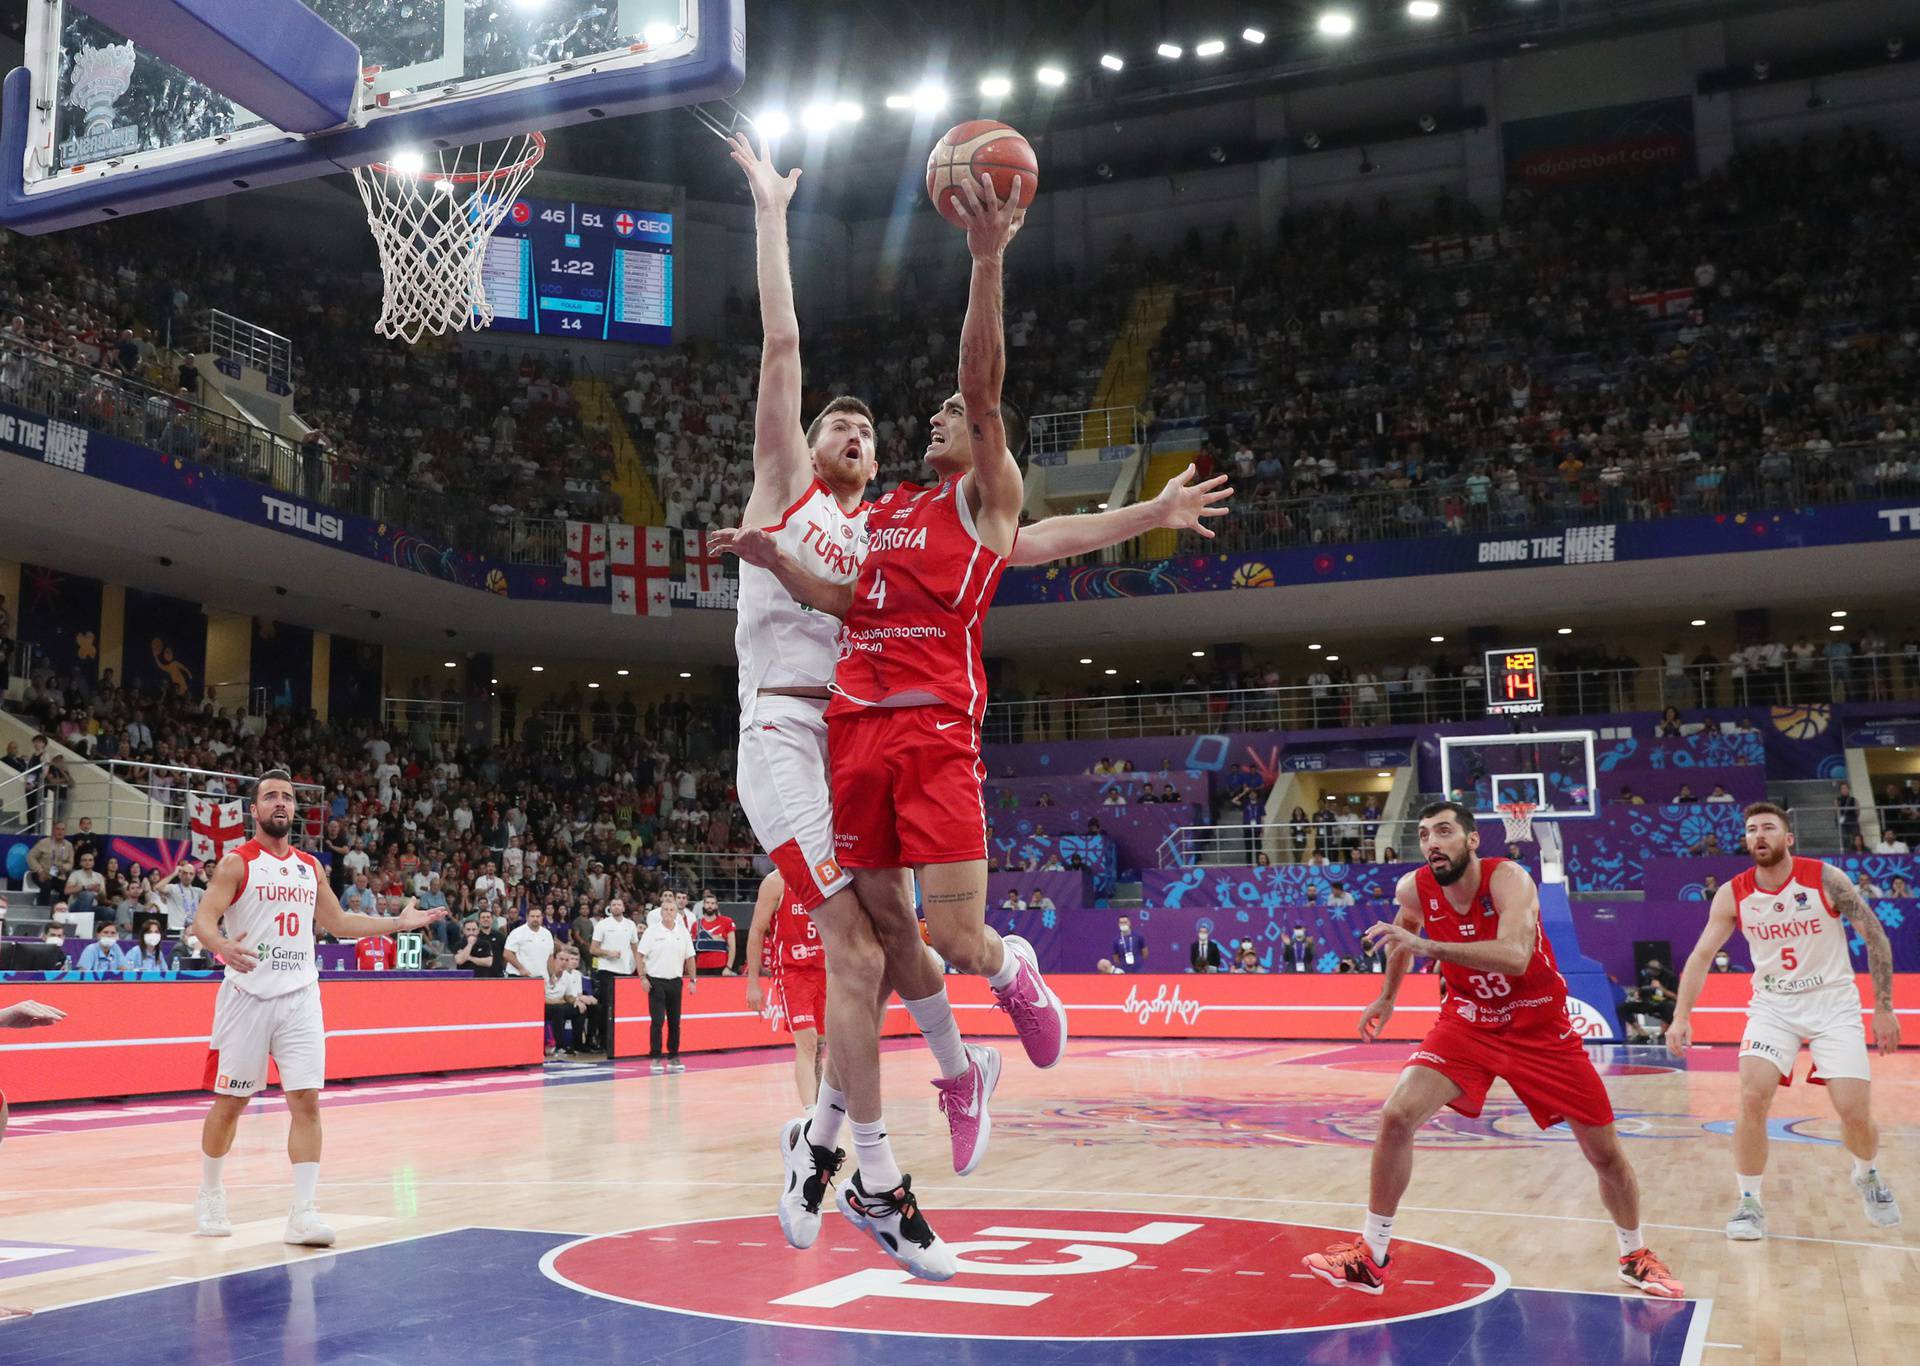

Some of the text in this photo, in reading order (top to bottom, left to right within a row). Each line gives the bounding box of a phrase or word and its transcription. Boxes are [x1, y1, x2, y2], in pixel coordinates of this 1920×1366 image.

[1525, 144, 1676, 178] adjarabet.com
[540, 208, 566, 224] 46
[581, 213, 604, 228] 51
[637, 219, 671, 234] GEO
[551, 258, 595, 276] 1:22
[561, 317, 582, 330] 14
[18, 419, 46, 451] THE
[44, 419, 89, 473] NOISE
[262, 495, 344, 542] TBILISI
[802, 520, 864, 577] TÜRKİY
[1478, 525, 1616, 564] BRING THE NOISE
[867, 568, 887, 610] 4
[1505, 653, 1535, 670] 1:22
[1506, 672, 1535, 699] 14
[1502, 703, 1544, 714] TISSOT
[256, 882, 315, 906] TÜRKİYE
[274, 911, 300, 937] 10
[807, 921, 817, 939] 5
[1746, 918, 1823, 941] TÜRKİYE
[272, 961, 302, 971] BBVA
[1781, 947, 1798, 971] 5
[1469, 972, 1512, 999] 33
[1777, 976, 1824, 991] Garanti
